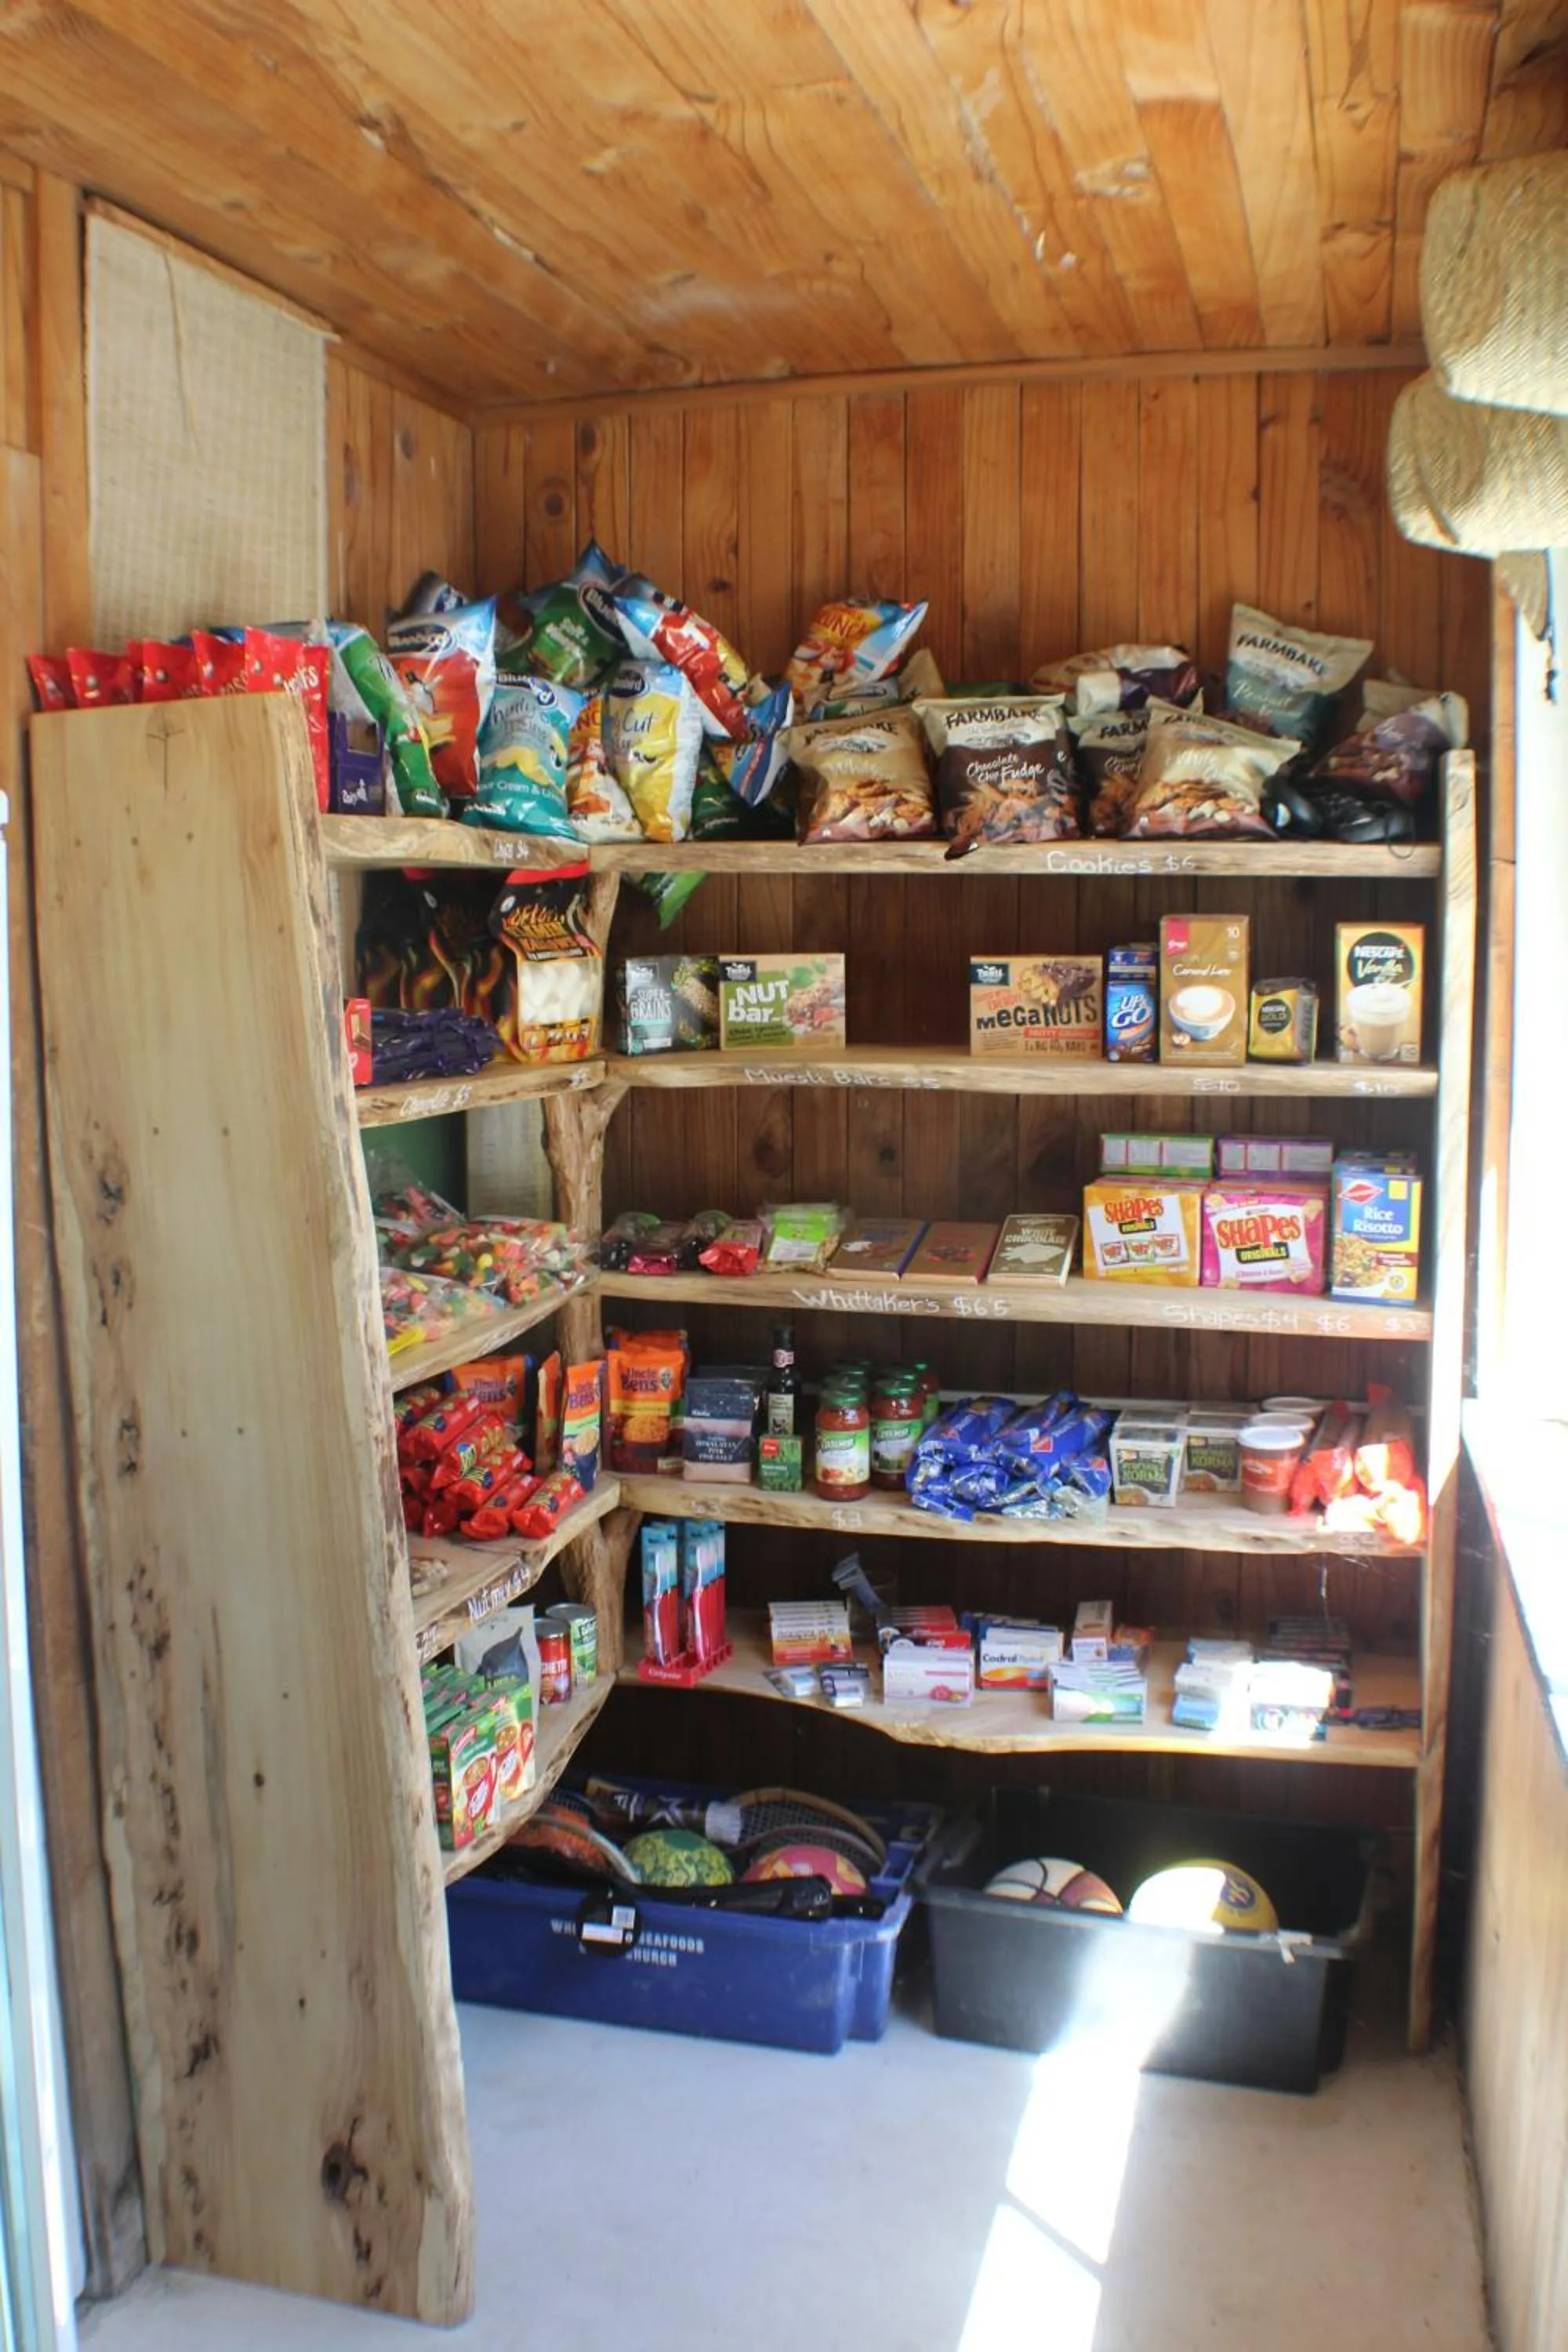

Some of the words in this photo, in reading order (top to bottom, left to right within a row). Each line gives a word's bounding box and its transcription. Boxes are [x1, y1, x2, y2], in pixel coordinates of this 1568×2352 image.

[1236, 632, 1329, 677] FARMBAKE
[1098, 717, 1149, 739] FARM
[966, 751, 1019, 779] Chocolate
[1000, 761, 1045, 786] Fudge
[1047, 851, 1153, 873] Cookies
[1226, 925, 1240, 938] 10
[735, 980, 789, 1006] NUT
[630, 1000, 672, 1019] GRAINS
[728, 999, 775, 1024] bar
[1111, 1007, 1152, 1029] GO
[744, 1067, 826, 1085] Muesli
[833, 1069, 891, 1085] Bars
[1365, 1206, 1393, 1221] Rice
[1353, 1219, 1403, 1235] Risotto
[792, 1288, 941, 1314] Whittaker's
[1163, 1305, 1258, 1327] Shapes
[982, 1653, 1018, 1662] Codral
[638, 1931, 705, 1954] SEAFOODS
